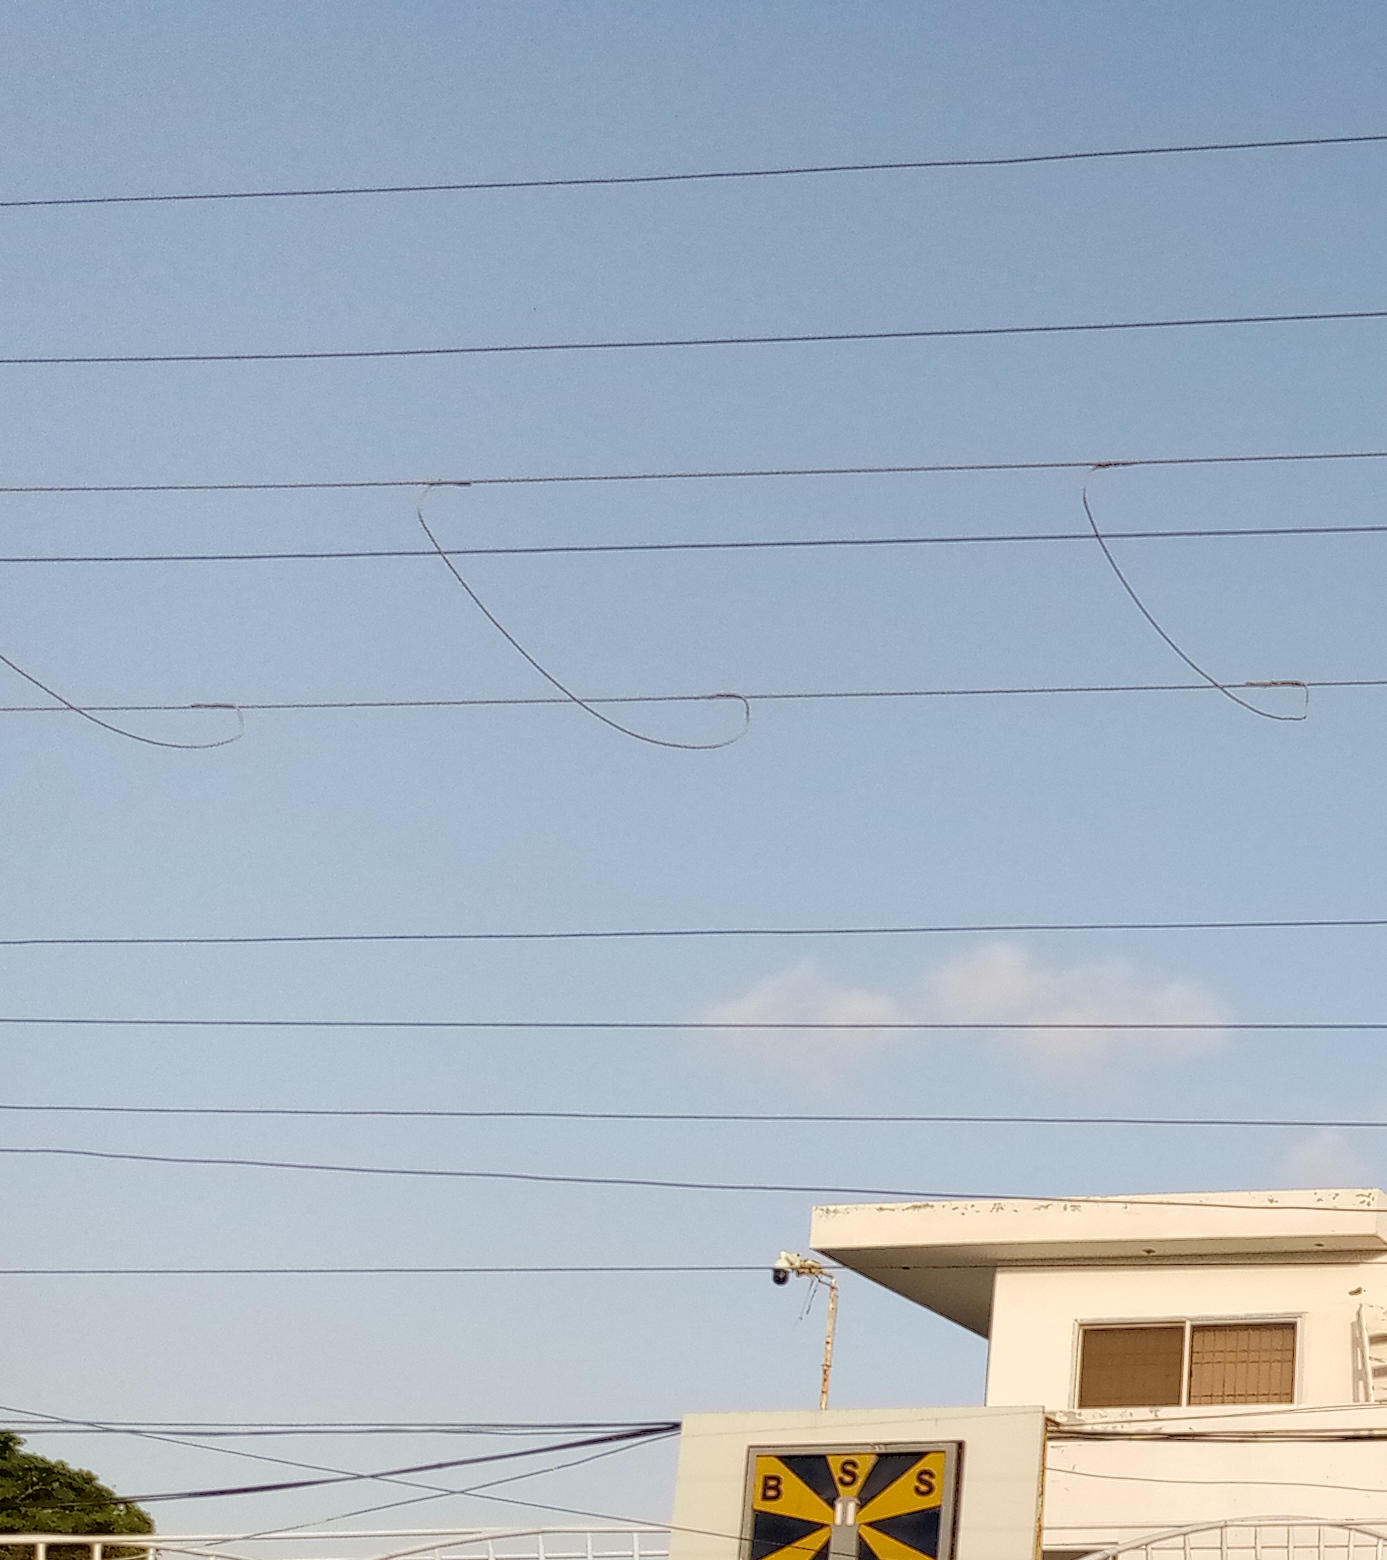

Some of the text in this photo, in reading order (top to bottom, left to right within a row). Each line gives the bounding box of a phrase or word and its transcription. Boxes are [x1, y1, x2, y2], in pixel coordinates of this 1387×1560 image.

[762, 1459, 936, 1501] B S S
